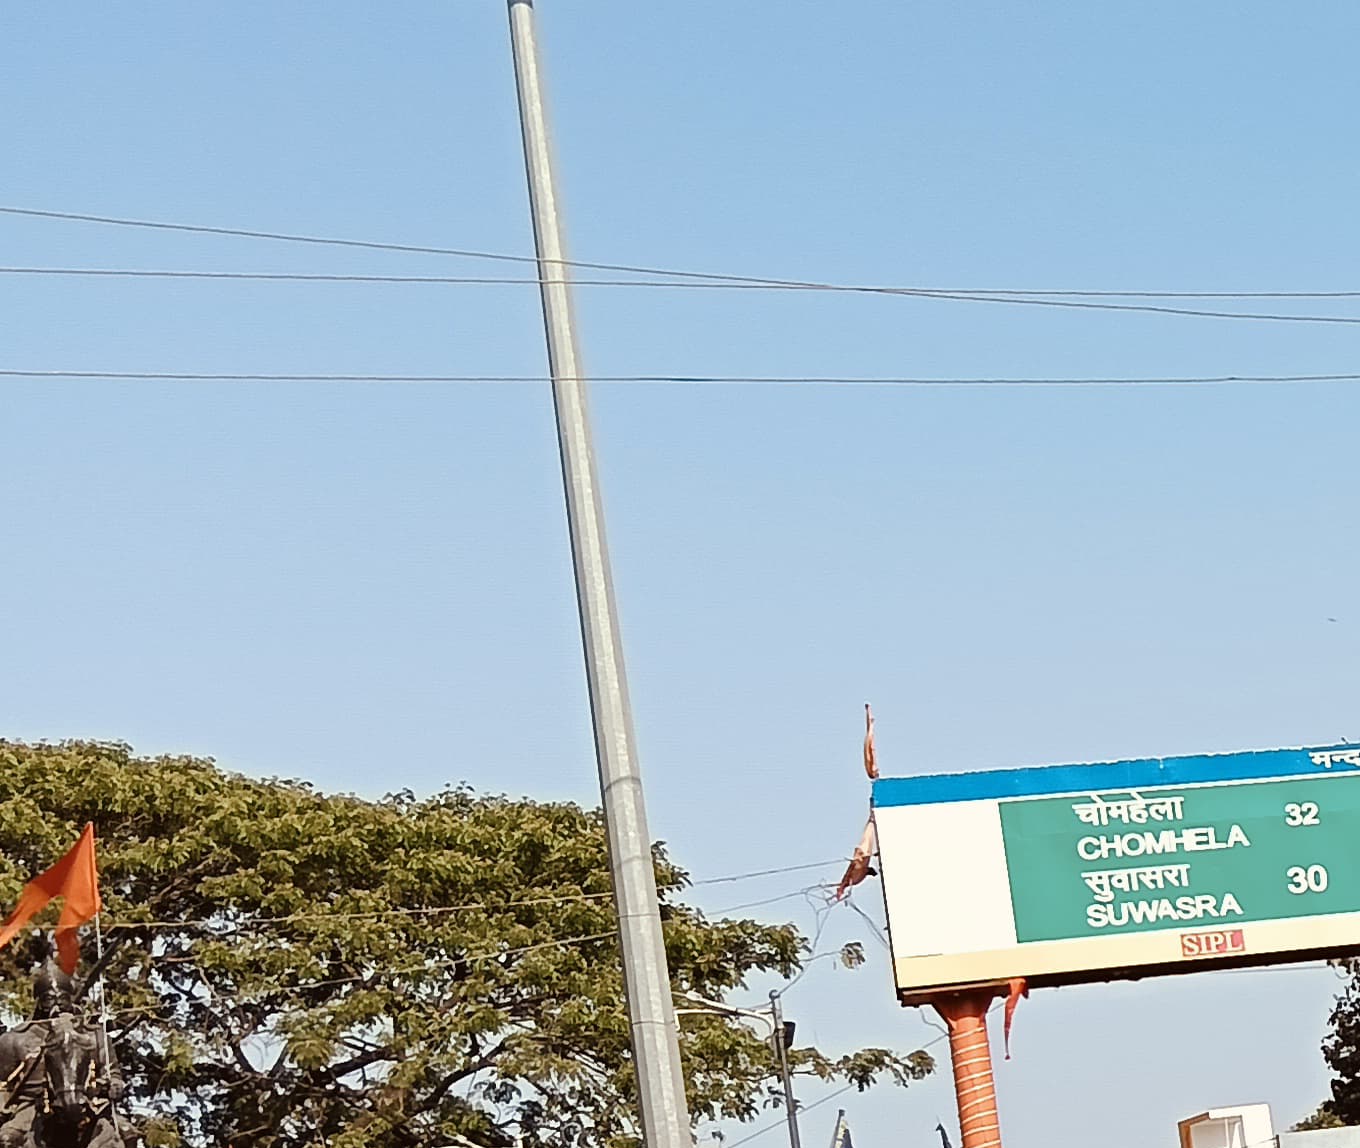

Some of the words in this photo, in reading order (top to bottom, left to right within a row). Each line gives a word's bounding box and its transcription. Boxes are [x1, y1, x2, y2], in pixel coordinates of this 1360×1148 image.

[1285, 803, 1319, 826] 32
[1077, 824, 1251, 861] CHOMHELA
[1081, 863, 1191, 902] सुवासरा
[1286, 865, 1329, 893] 30
[1086, 892, 1244, 930] SUWASRA
[1182, 932, 1244, 956] SIPL
